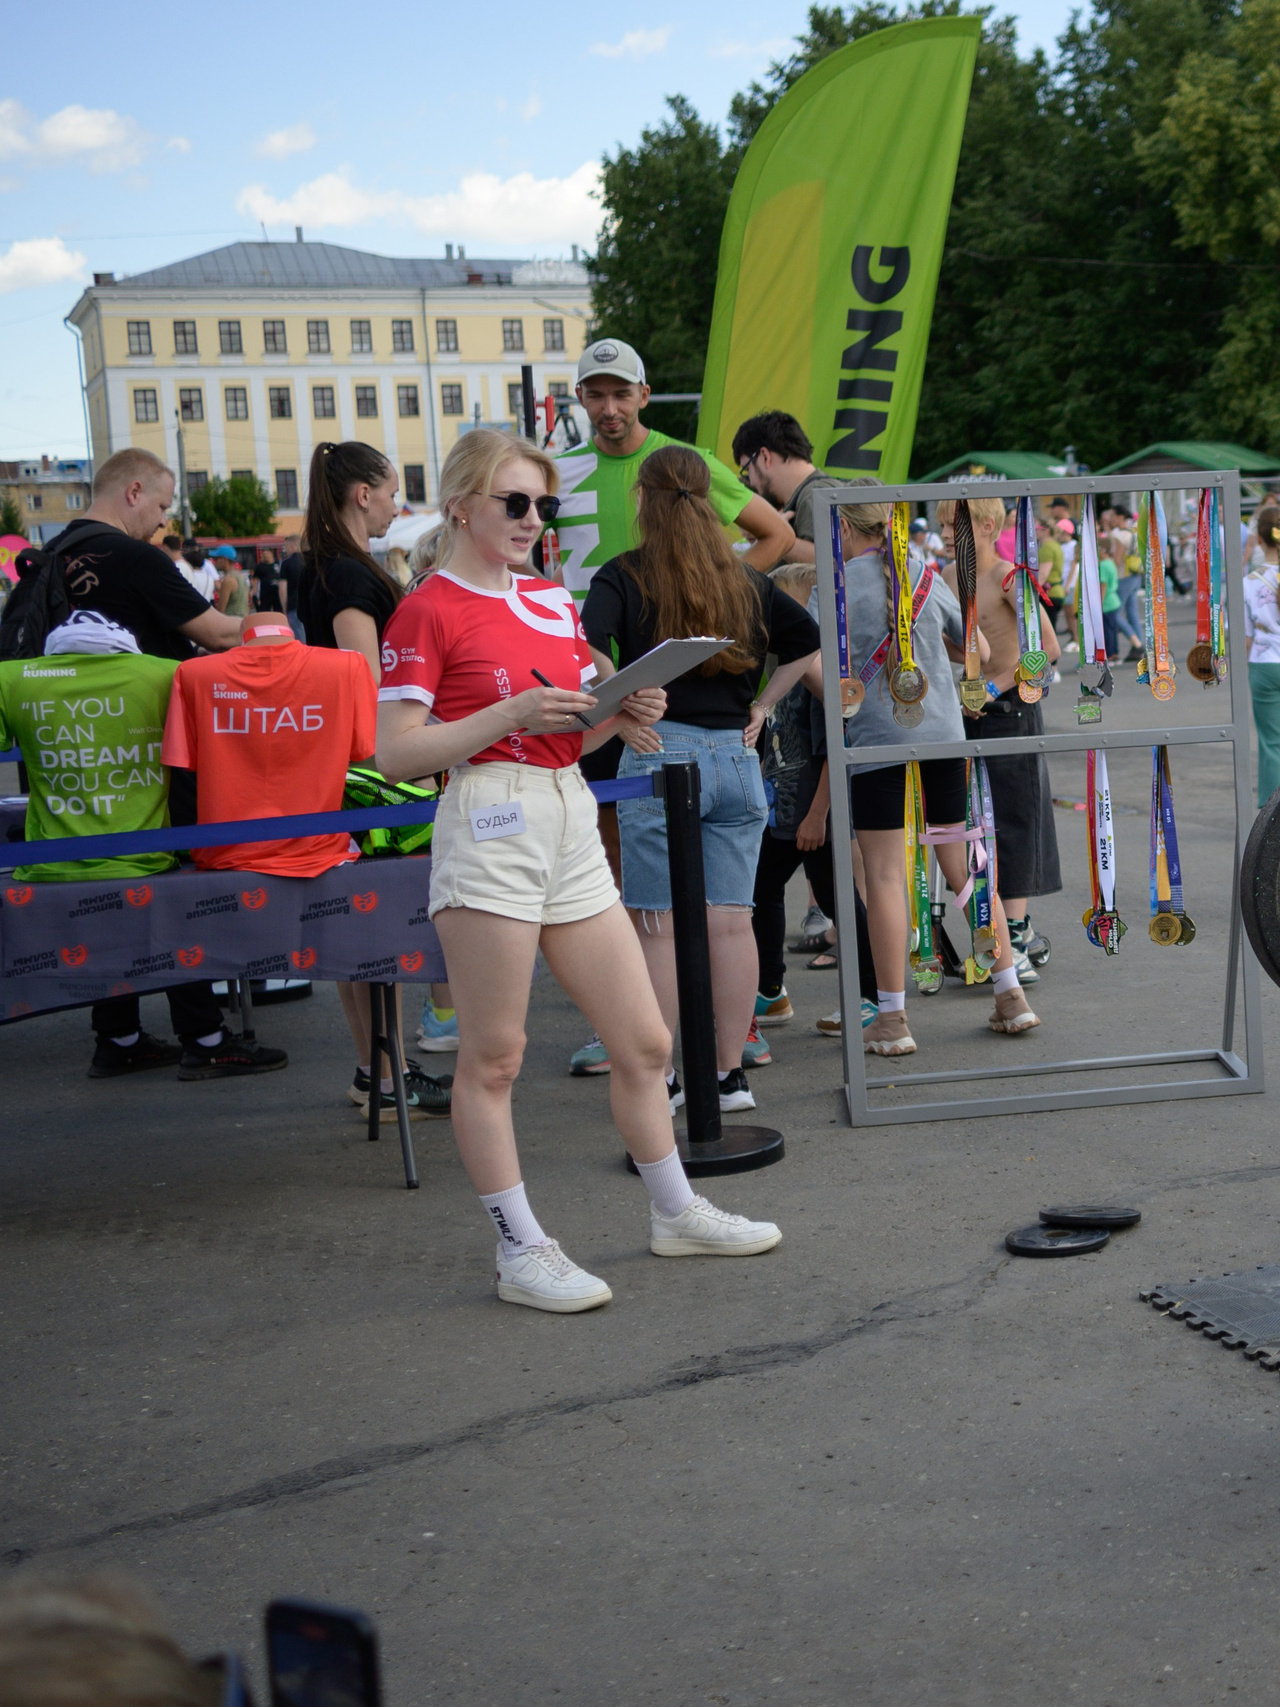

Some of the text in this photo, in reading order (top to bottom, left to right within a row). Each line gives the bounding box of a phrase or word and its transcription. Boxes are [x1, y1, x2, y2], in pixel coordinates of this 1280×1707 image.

[901, 632, 908, 643] 21
[23, 668, 77, 678] RUNNING
[213, 691, 248, 699] SKIING
[63, 697, 124, 719] YOU
[213, 705, 324, 734] ШТАБ
[36, 723, 95, 745] CAN
[40, 745, 140, 769] DREAM
[43, 767, 164, 792] YOU CAN
[46, 795, 86, 815] DO
[476, 812, 518, 830] СУДЬЯ
[1100, 838, 1107, 850] 21
[79, 891, 120, 907] холмы
[196, 894, 236, 908] холмы
[308, 896, 348, 910] холмы
[69, 900, 123, 918] Вятские
[186, 902, 239, 920] Вятские
[300, 904, 350, 922] Вятские
[13, 950, 55, 966] холмы
[132, 951, 173, 966] холмы
[246, 953, 287, 968] холмы
[358, 956, 396, 970] холмы
[5, 959, 58, 978] Вятские
[124, 960, 175, 978] Вятские
